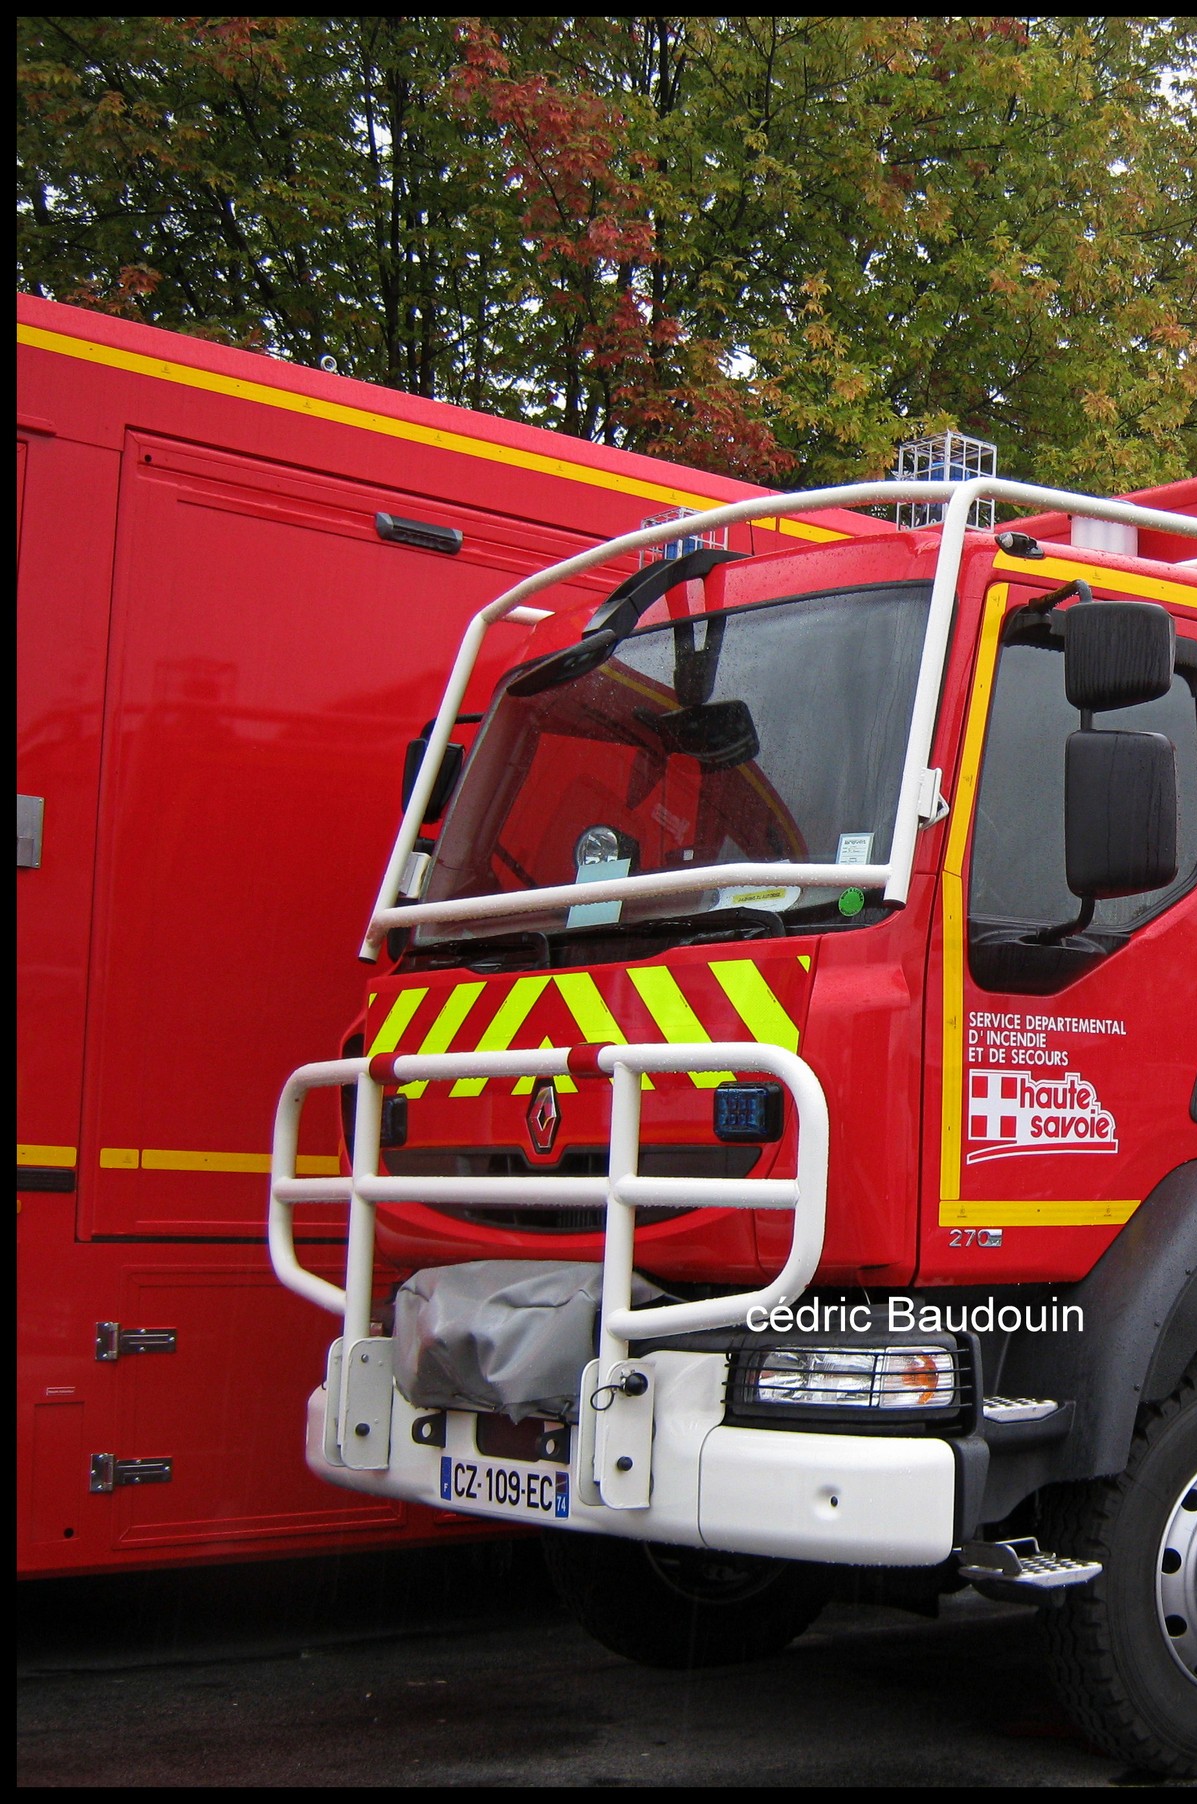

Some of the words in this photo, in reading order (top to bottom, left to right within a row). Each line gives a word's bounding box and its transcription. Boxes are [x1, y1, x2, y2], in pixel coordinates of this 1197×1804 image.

[969, 1012, 1021, 1029] SERVICE
[1025, 1015, 1127, 1034] DEPARTEMENTAL
[968, 1048, 984, 1063] ET
[989, 1049, 1006, 1064] DE
[1011, 1050, 1069, 1066] SECOURS
[1019, 1078, 1091, 1109] haute
[1030, 1109, 1110, 1138] savoie
[454, 1463, 553, 1511] CZ-109-EC
[556, 1496, 566, 1512] 74
